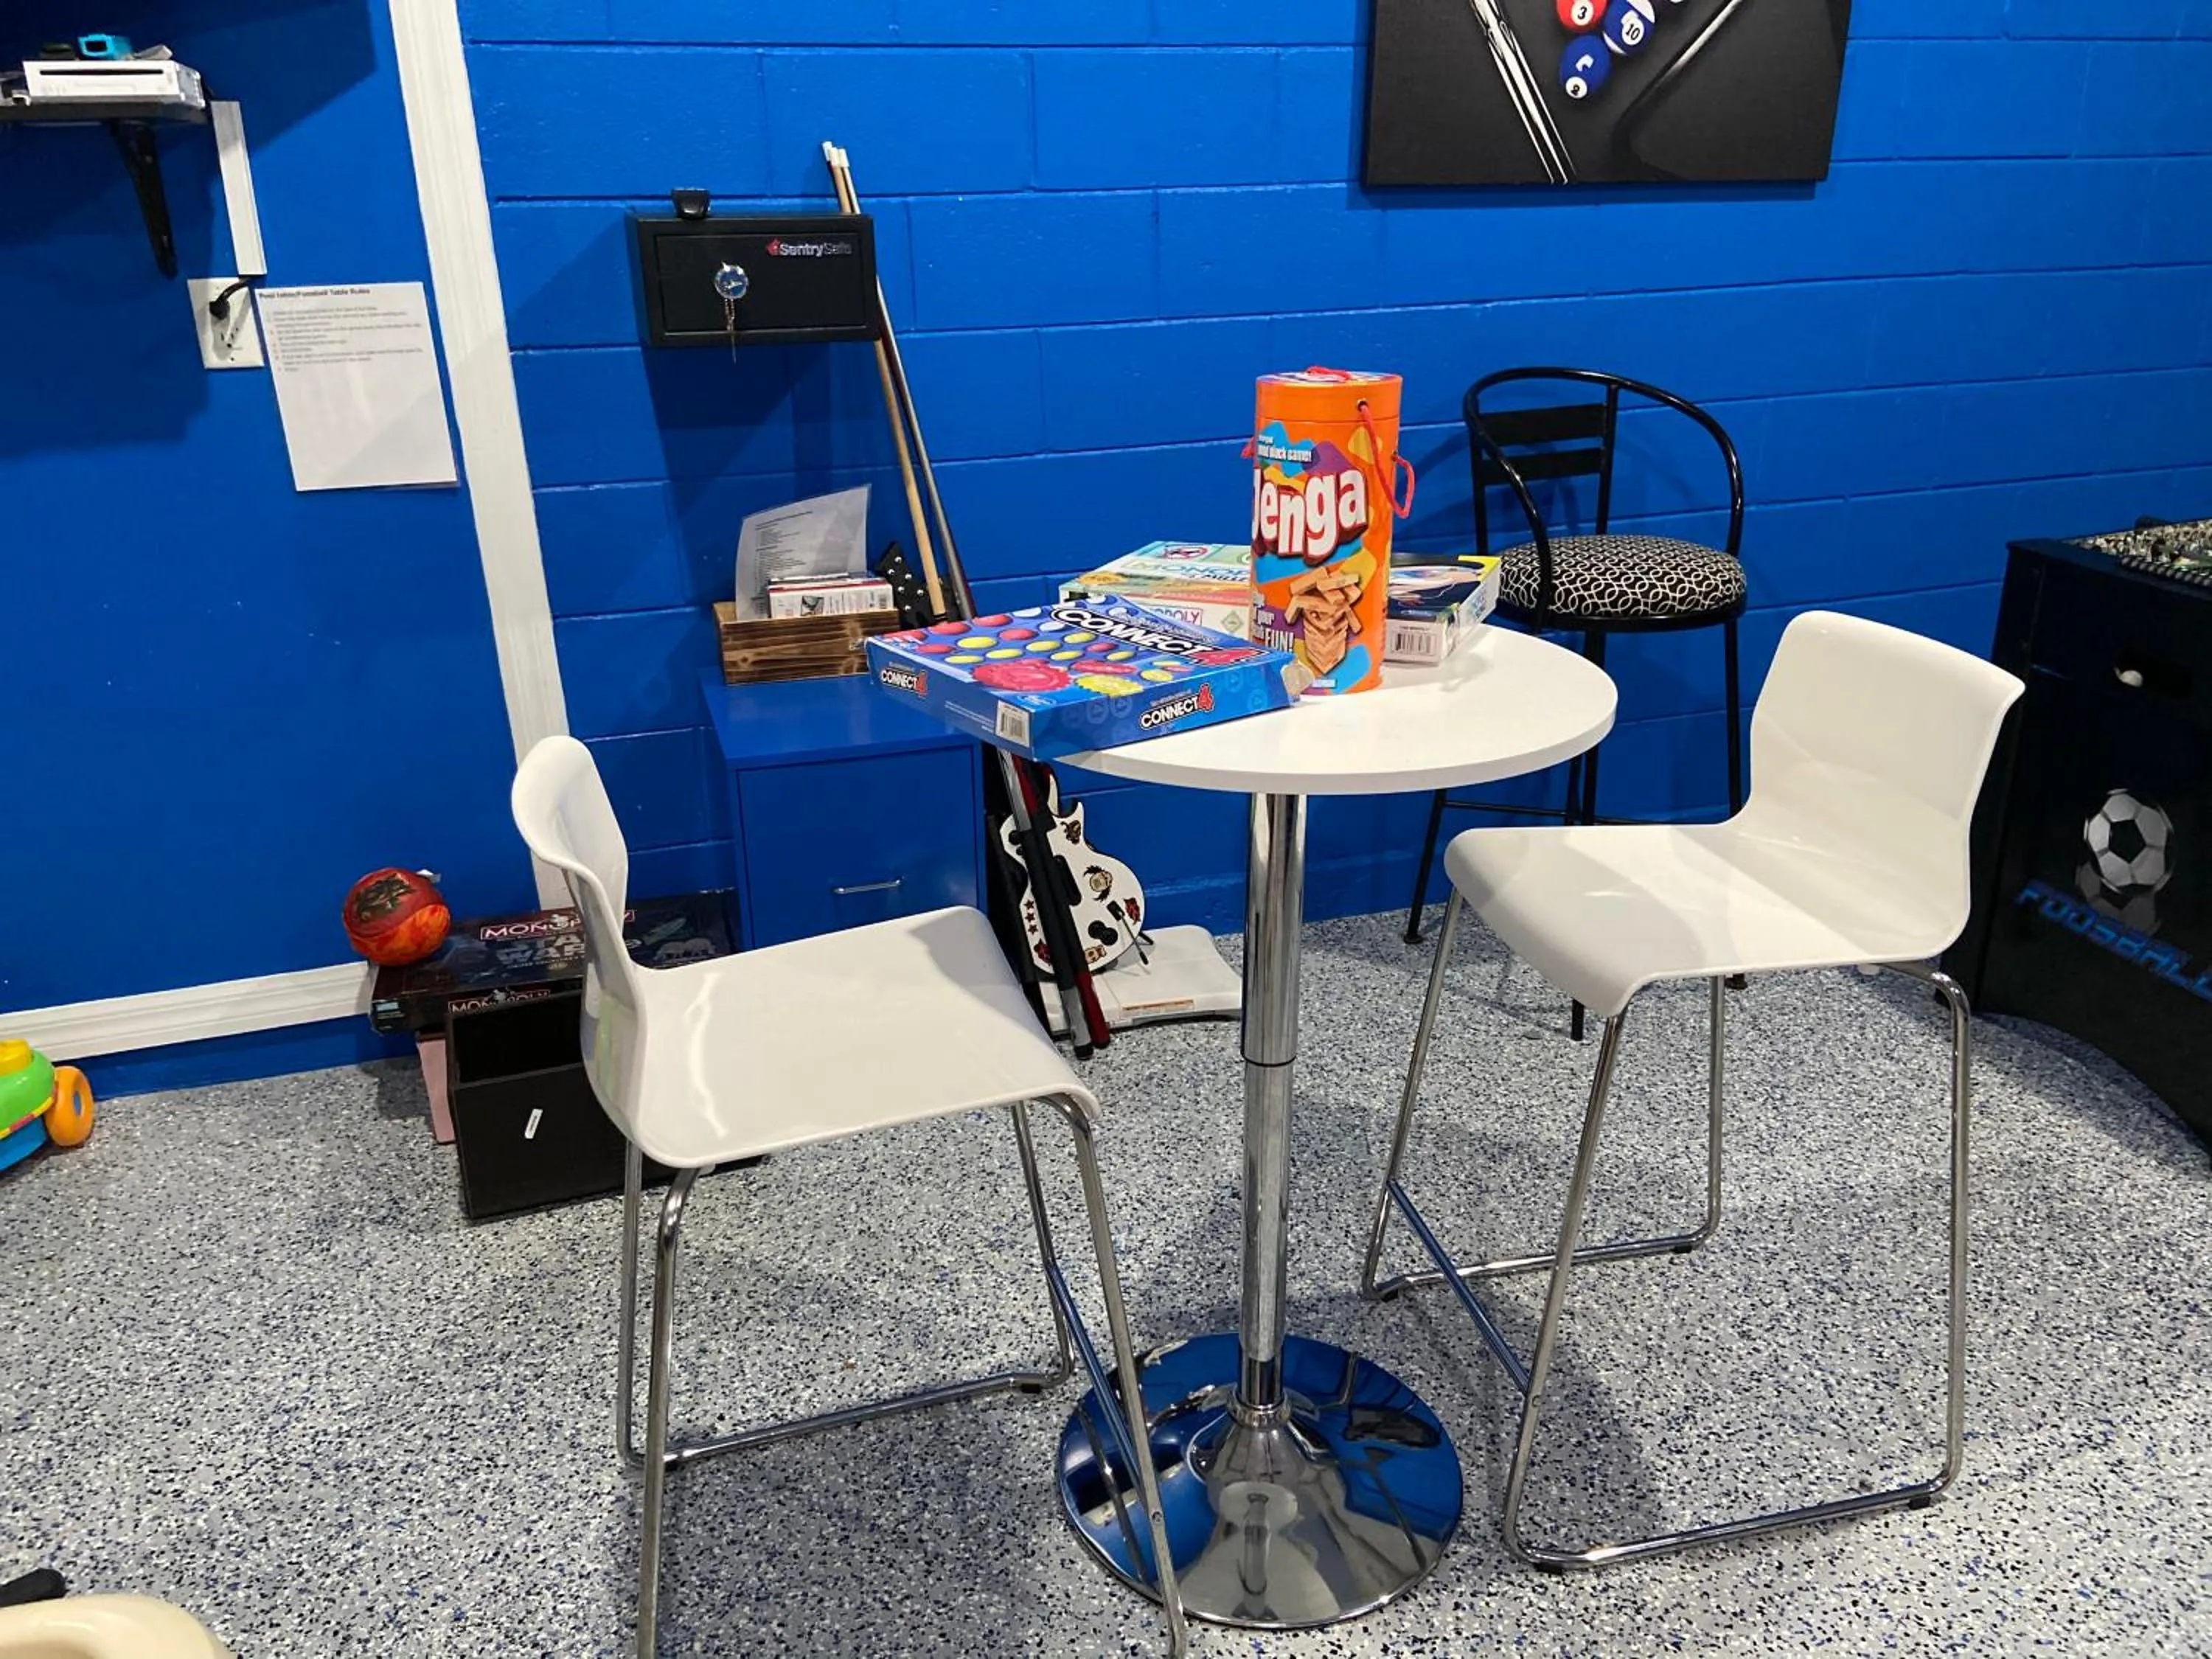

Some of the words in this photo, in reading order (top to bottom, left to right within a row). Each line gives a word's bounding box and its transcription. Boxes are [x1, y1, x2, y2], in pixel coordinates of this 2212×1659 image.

[1576, 6, 1588, 20] 3
[1625, 23, 1641, 41] 10
[779, 241, 852, 257] SentrySafe
[1056, 609, 1213, 657] CONNECT
[1265, 627, 1294, 653] FUN!
[880, 669, 918, 689] CONNECT
[917, 670, 928, 698] 4
[1141, 696, 1198, 728] CONNECT
[1197, 683, 1214, 711] 4
